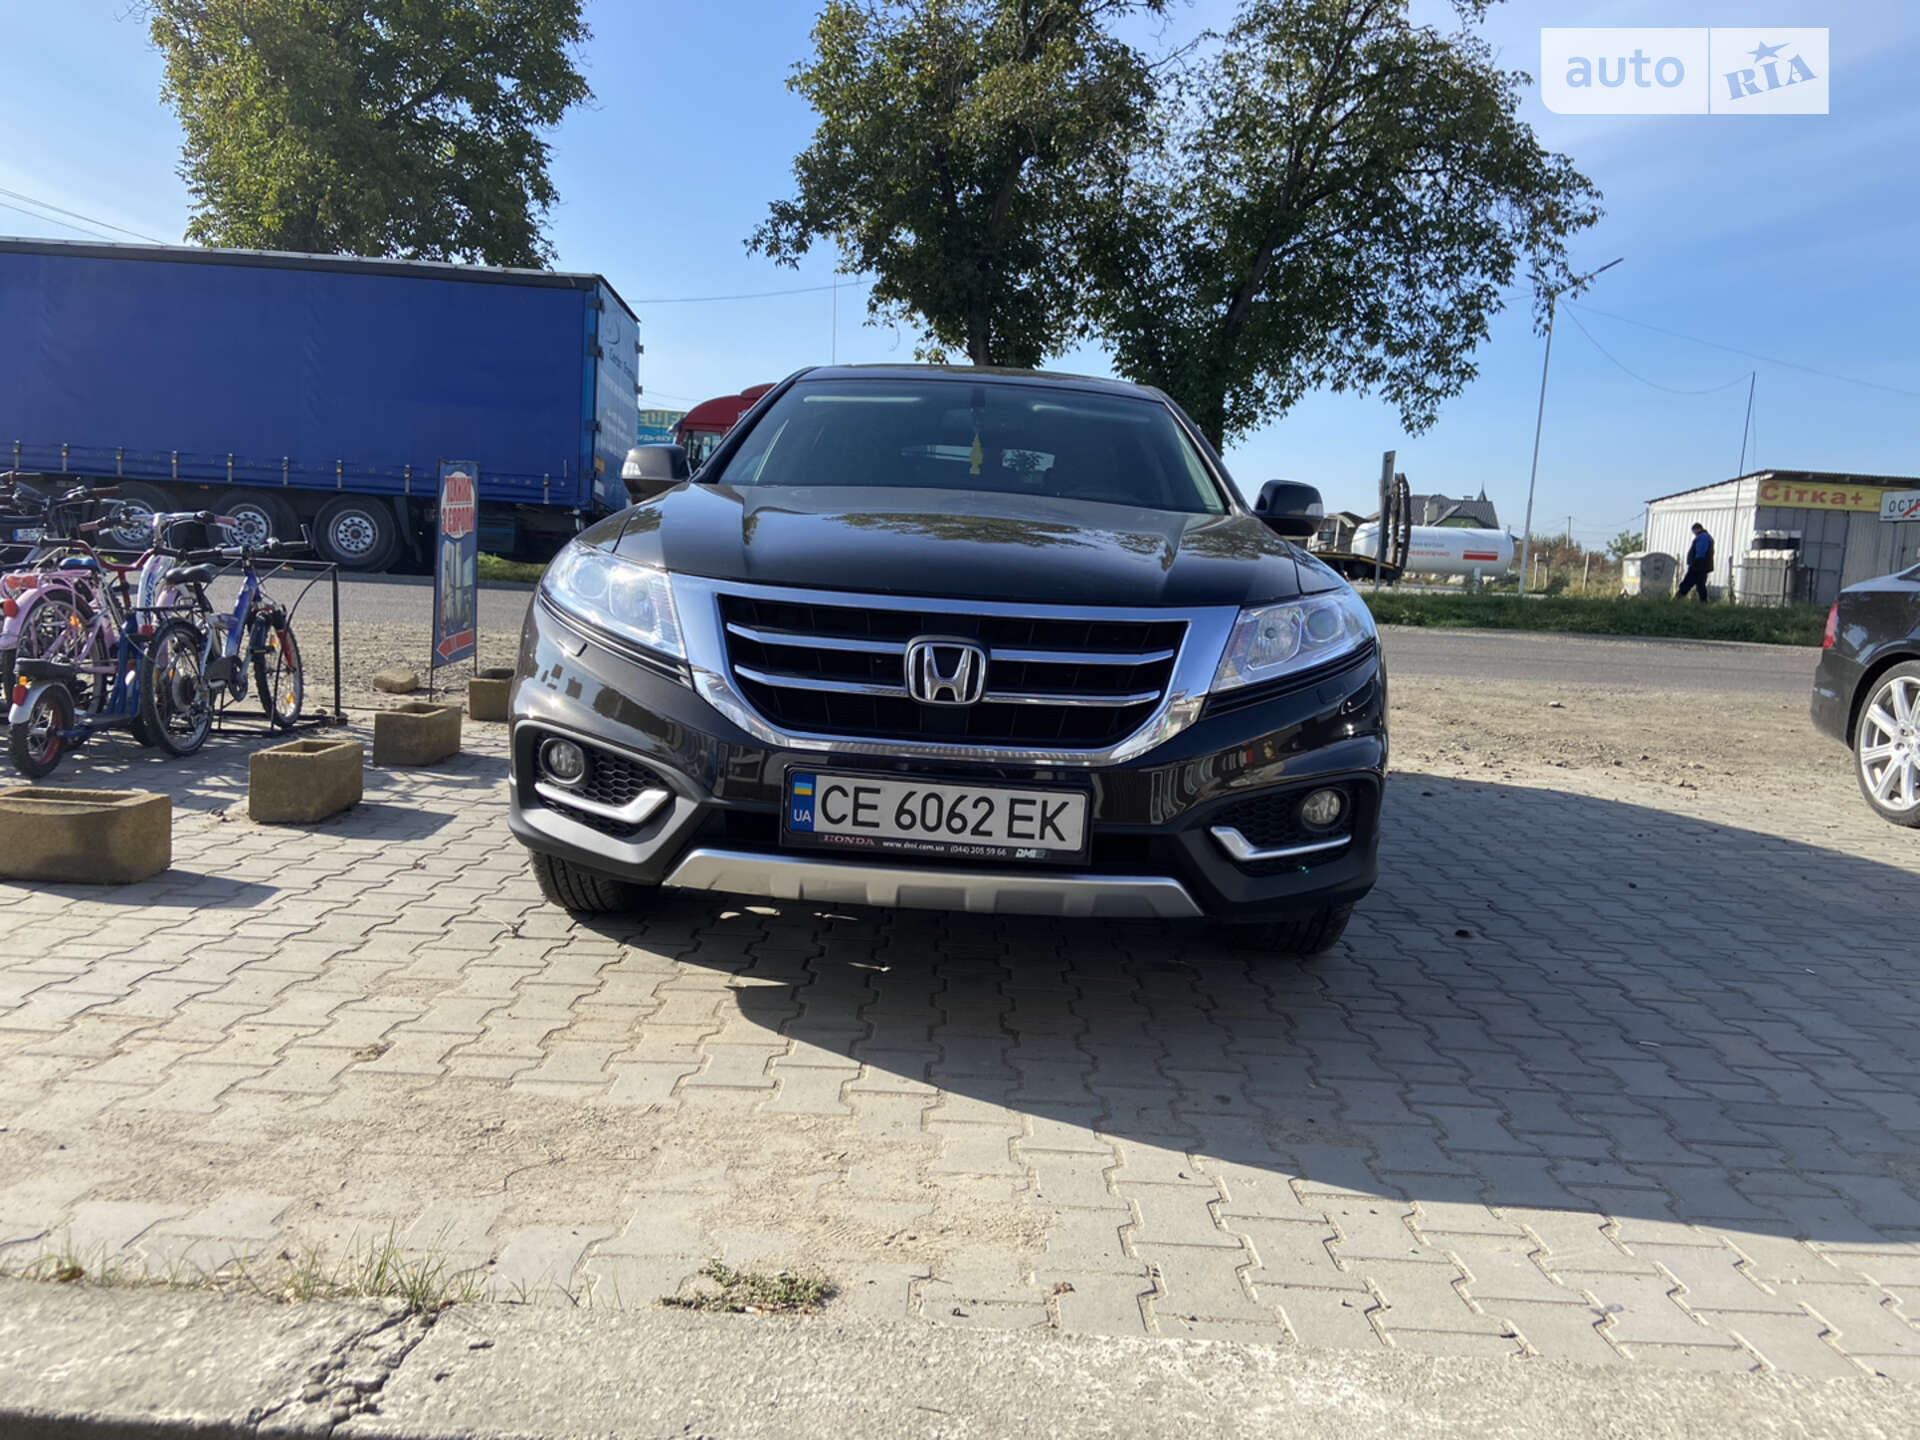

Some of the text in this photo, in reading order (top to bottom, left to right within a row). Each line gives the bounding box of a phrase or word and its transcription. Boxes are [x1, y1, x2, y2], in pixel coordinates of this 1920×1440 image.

[1760, 482, 1863, 506] Сітка+
[793, 808, 812, 823] UA
[821, 784, 1070, 842] CE 6062 EK
[823, 834, 876, 846] HONDA
